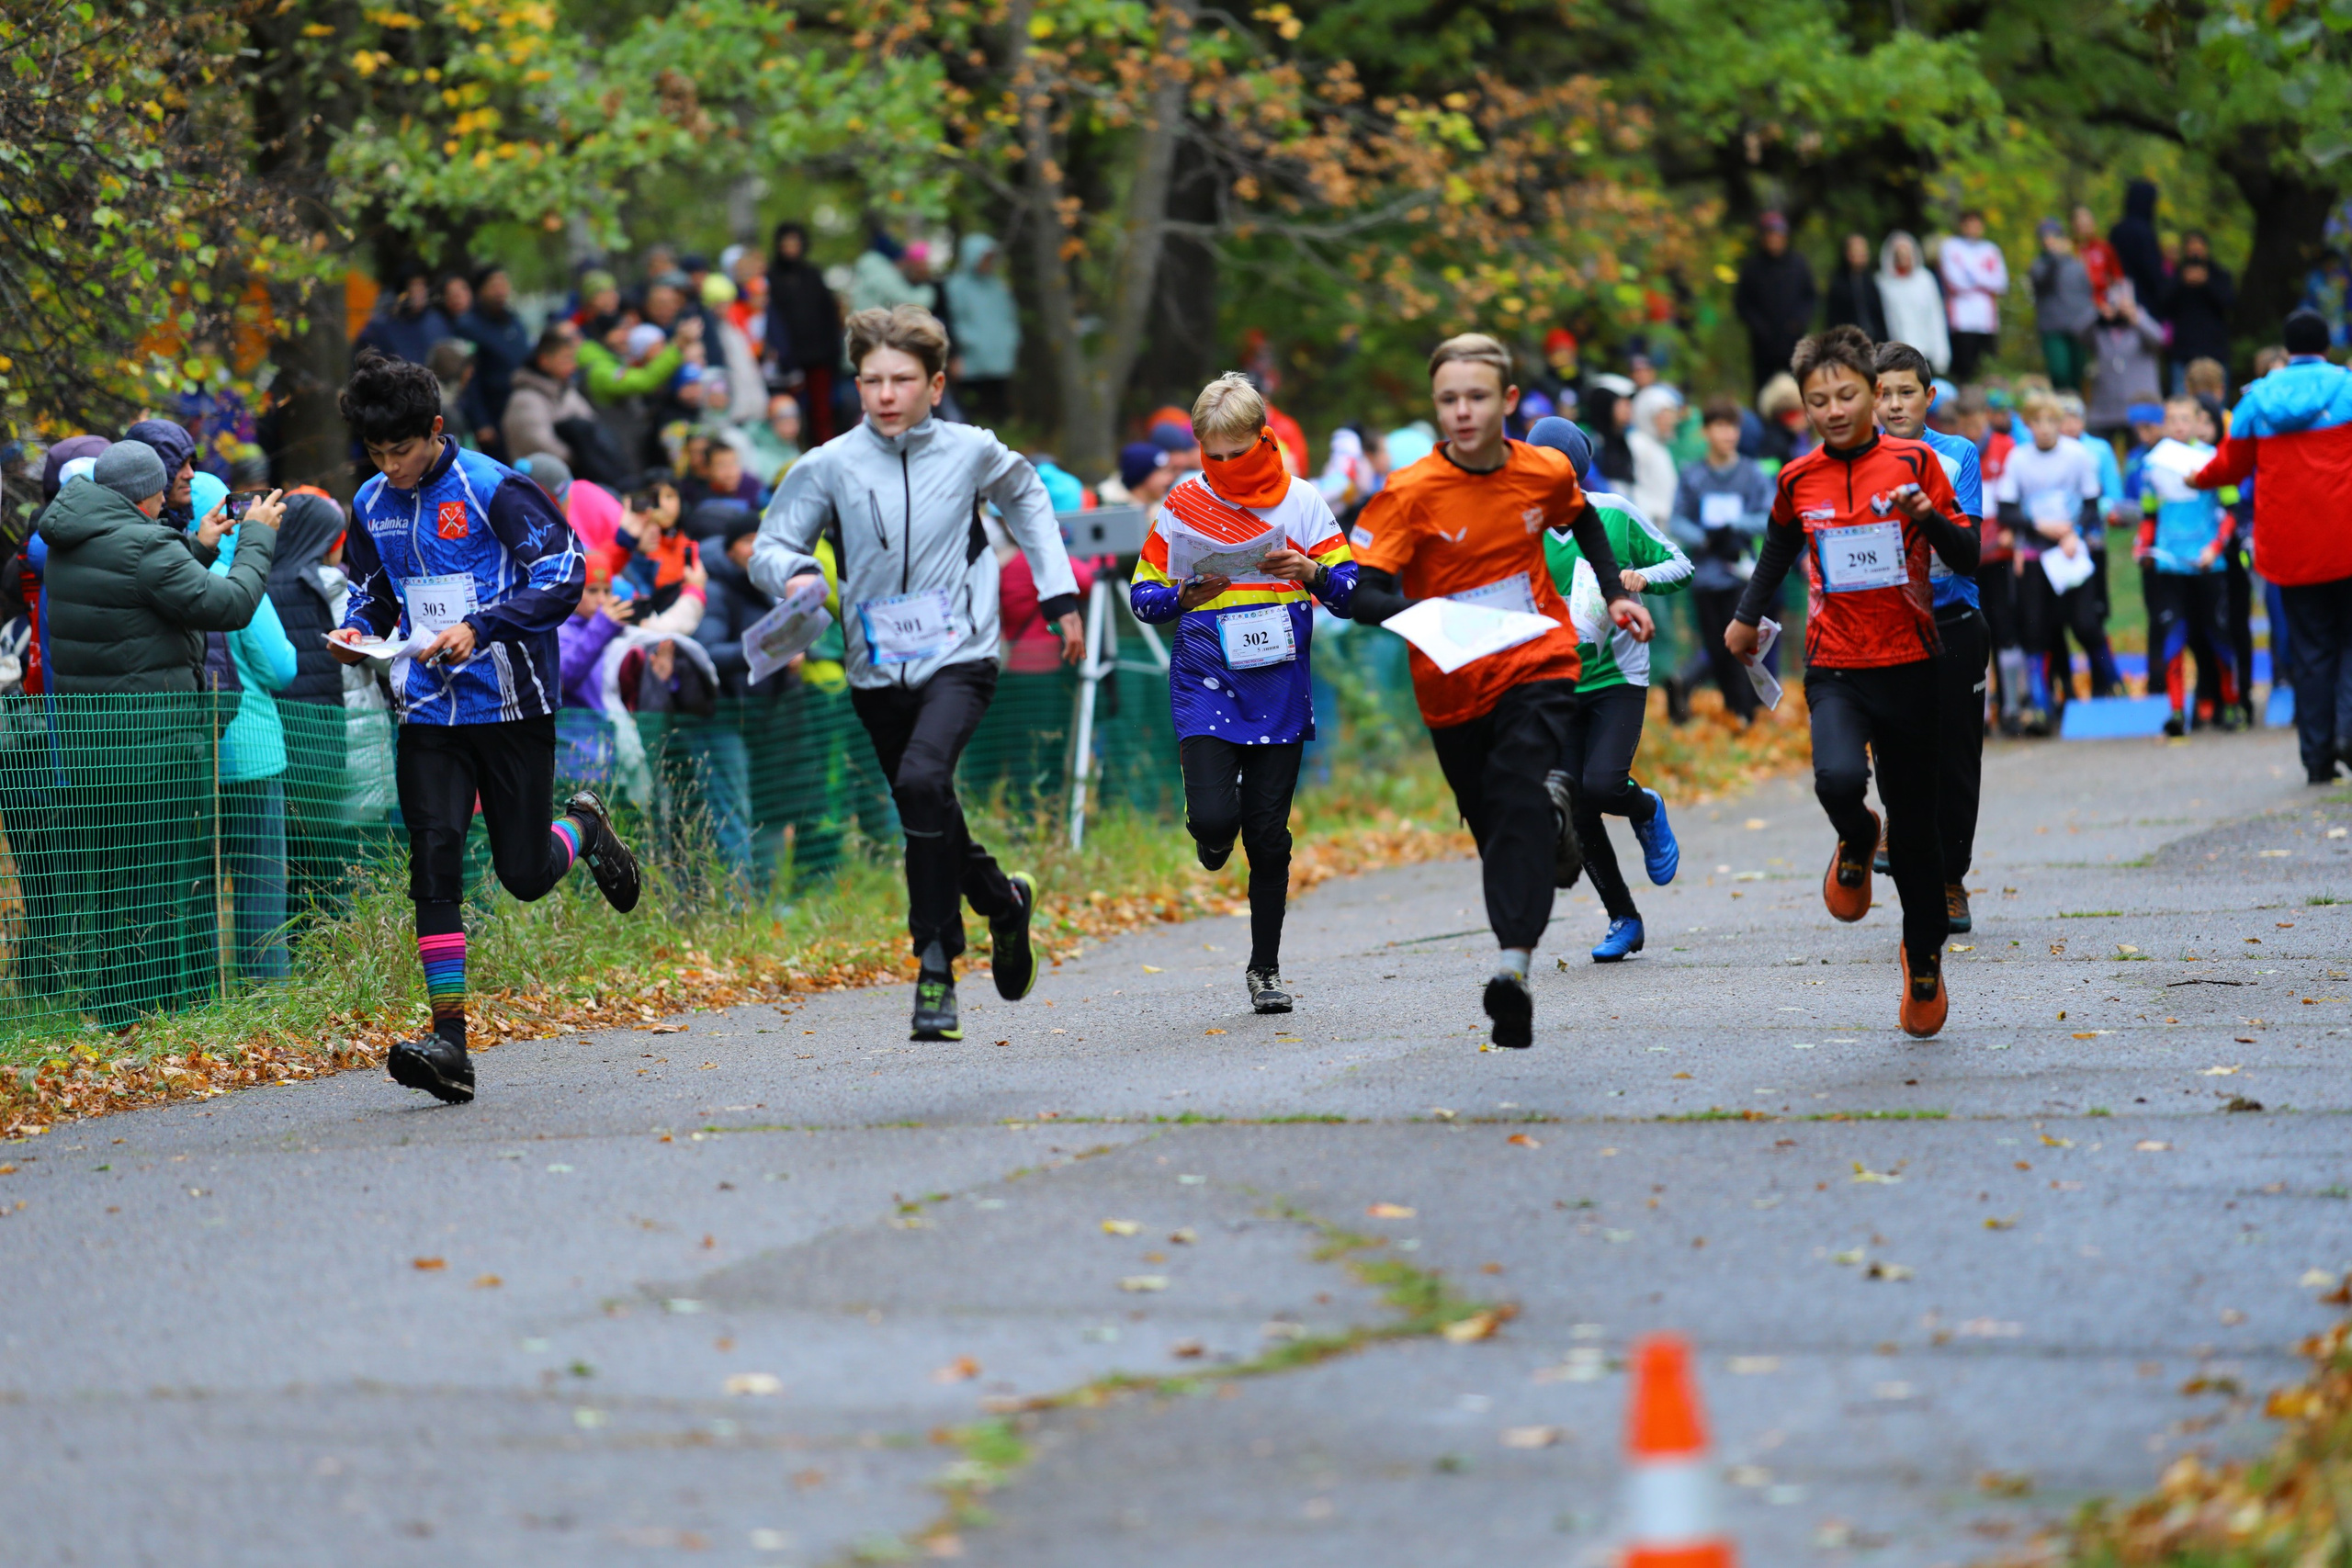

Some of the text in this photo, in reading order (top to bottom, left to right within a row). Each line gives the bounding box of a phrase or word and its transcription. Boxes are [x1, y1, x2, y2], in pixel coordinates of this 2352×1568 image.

[371, 516, 409, 531] kalinka
[1848, 550, 1877, 568] 298
[423, 603, 446, 616] 303
[894, 617, 922, 637] 301
[1243, 631, 1269, 648] 302
